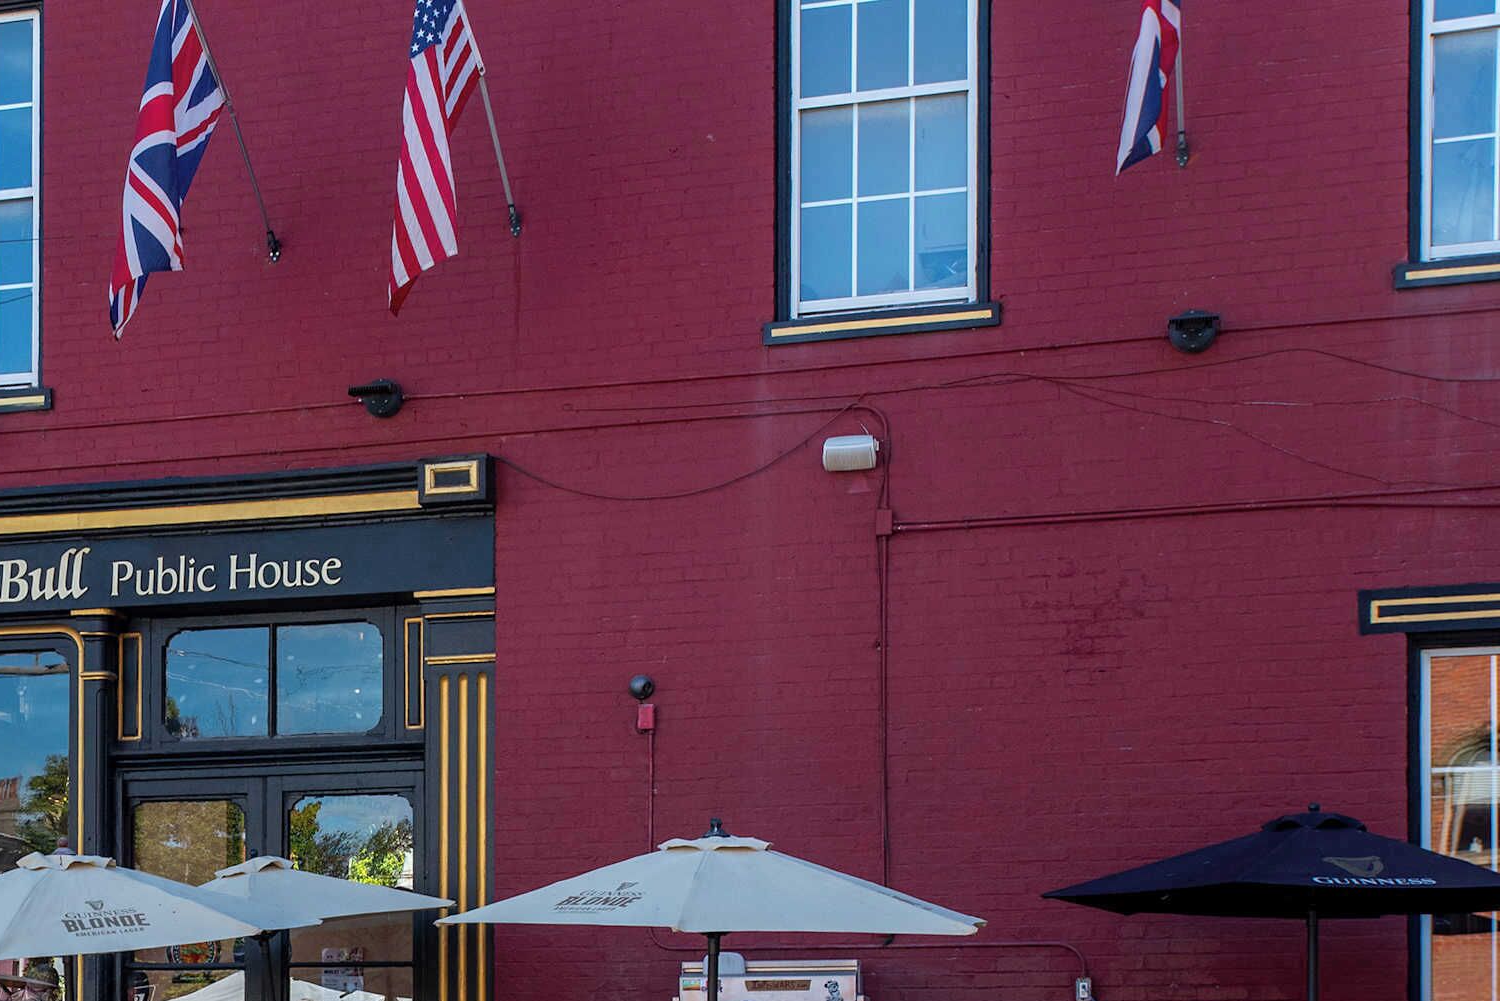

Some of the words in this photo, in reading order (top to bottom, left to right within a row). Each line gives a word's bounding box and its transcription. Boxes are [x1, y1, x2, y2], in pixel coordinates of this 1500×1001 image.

[111, 555, 217, 597] Public
[229, 552, 343, 591] House
[1312, 876, 1437, 886] GUINNESS
[64, 908, 137, 919] GUINNESS
[61, 913, 151, 933] BLONDE
